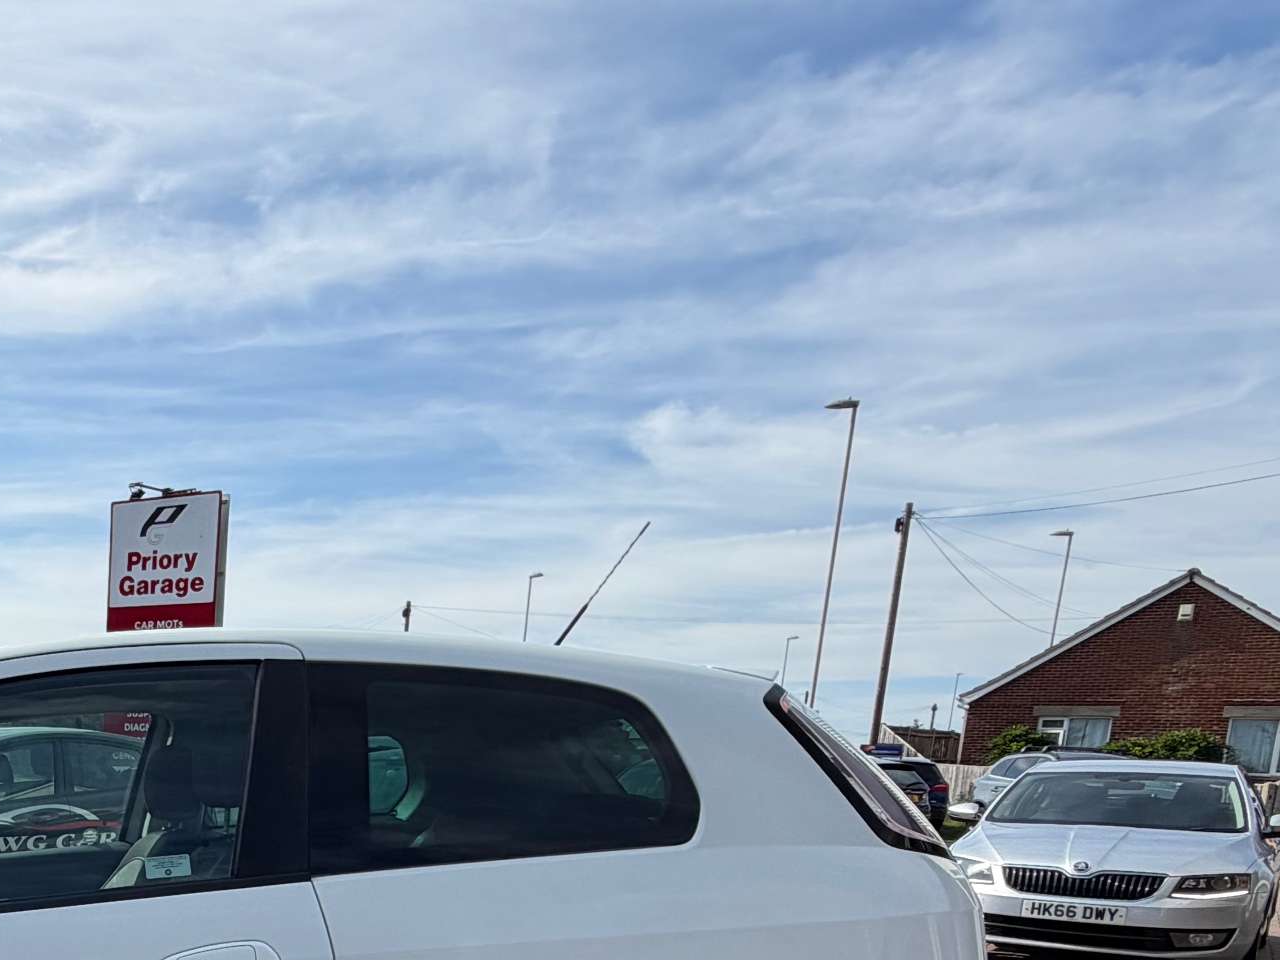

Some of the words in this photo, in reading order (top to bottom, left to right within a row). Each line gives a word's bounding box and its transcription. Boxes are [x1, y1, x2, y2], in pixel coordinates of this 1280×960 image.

[126, 550, 199, 573] Priory
[118, 575, 205, 598] Garage
[134, 620, 155, 630] CAR
[156, 619, 184, 630] MOTs
[1030, 901, 1077, 918] HK66
[1081, 906, 1119, 921] DWY
